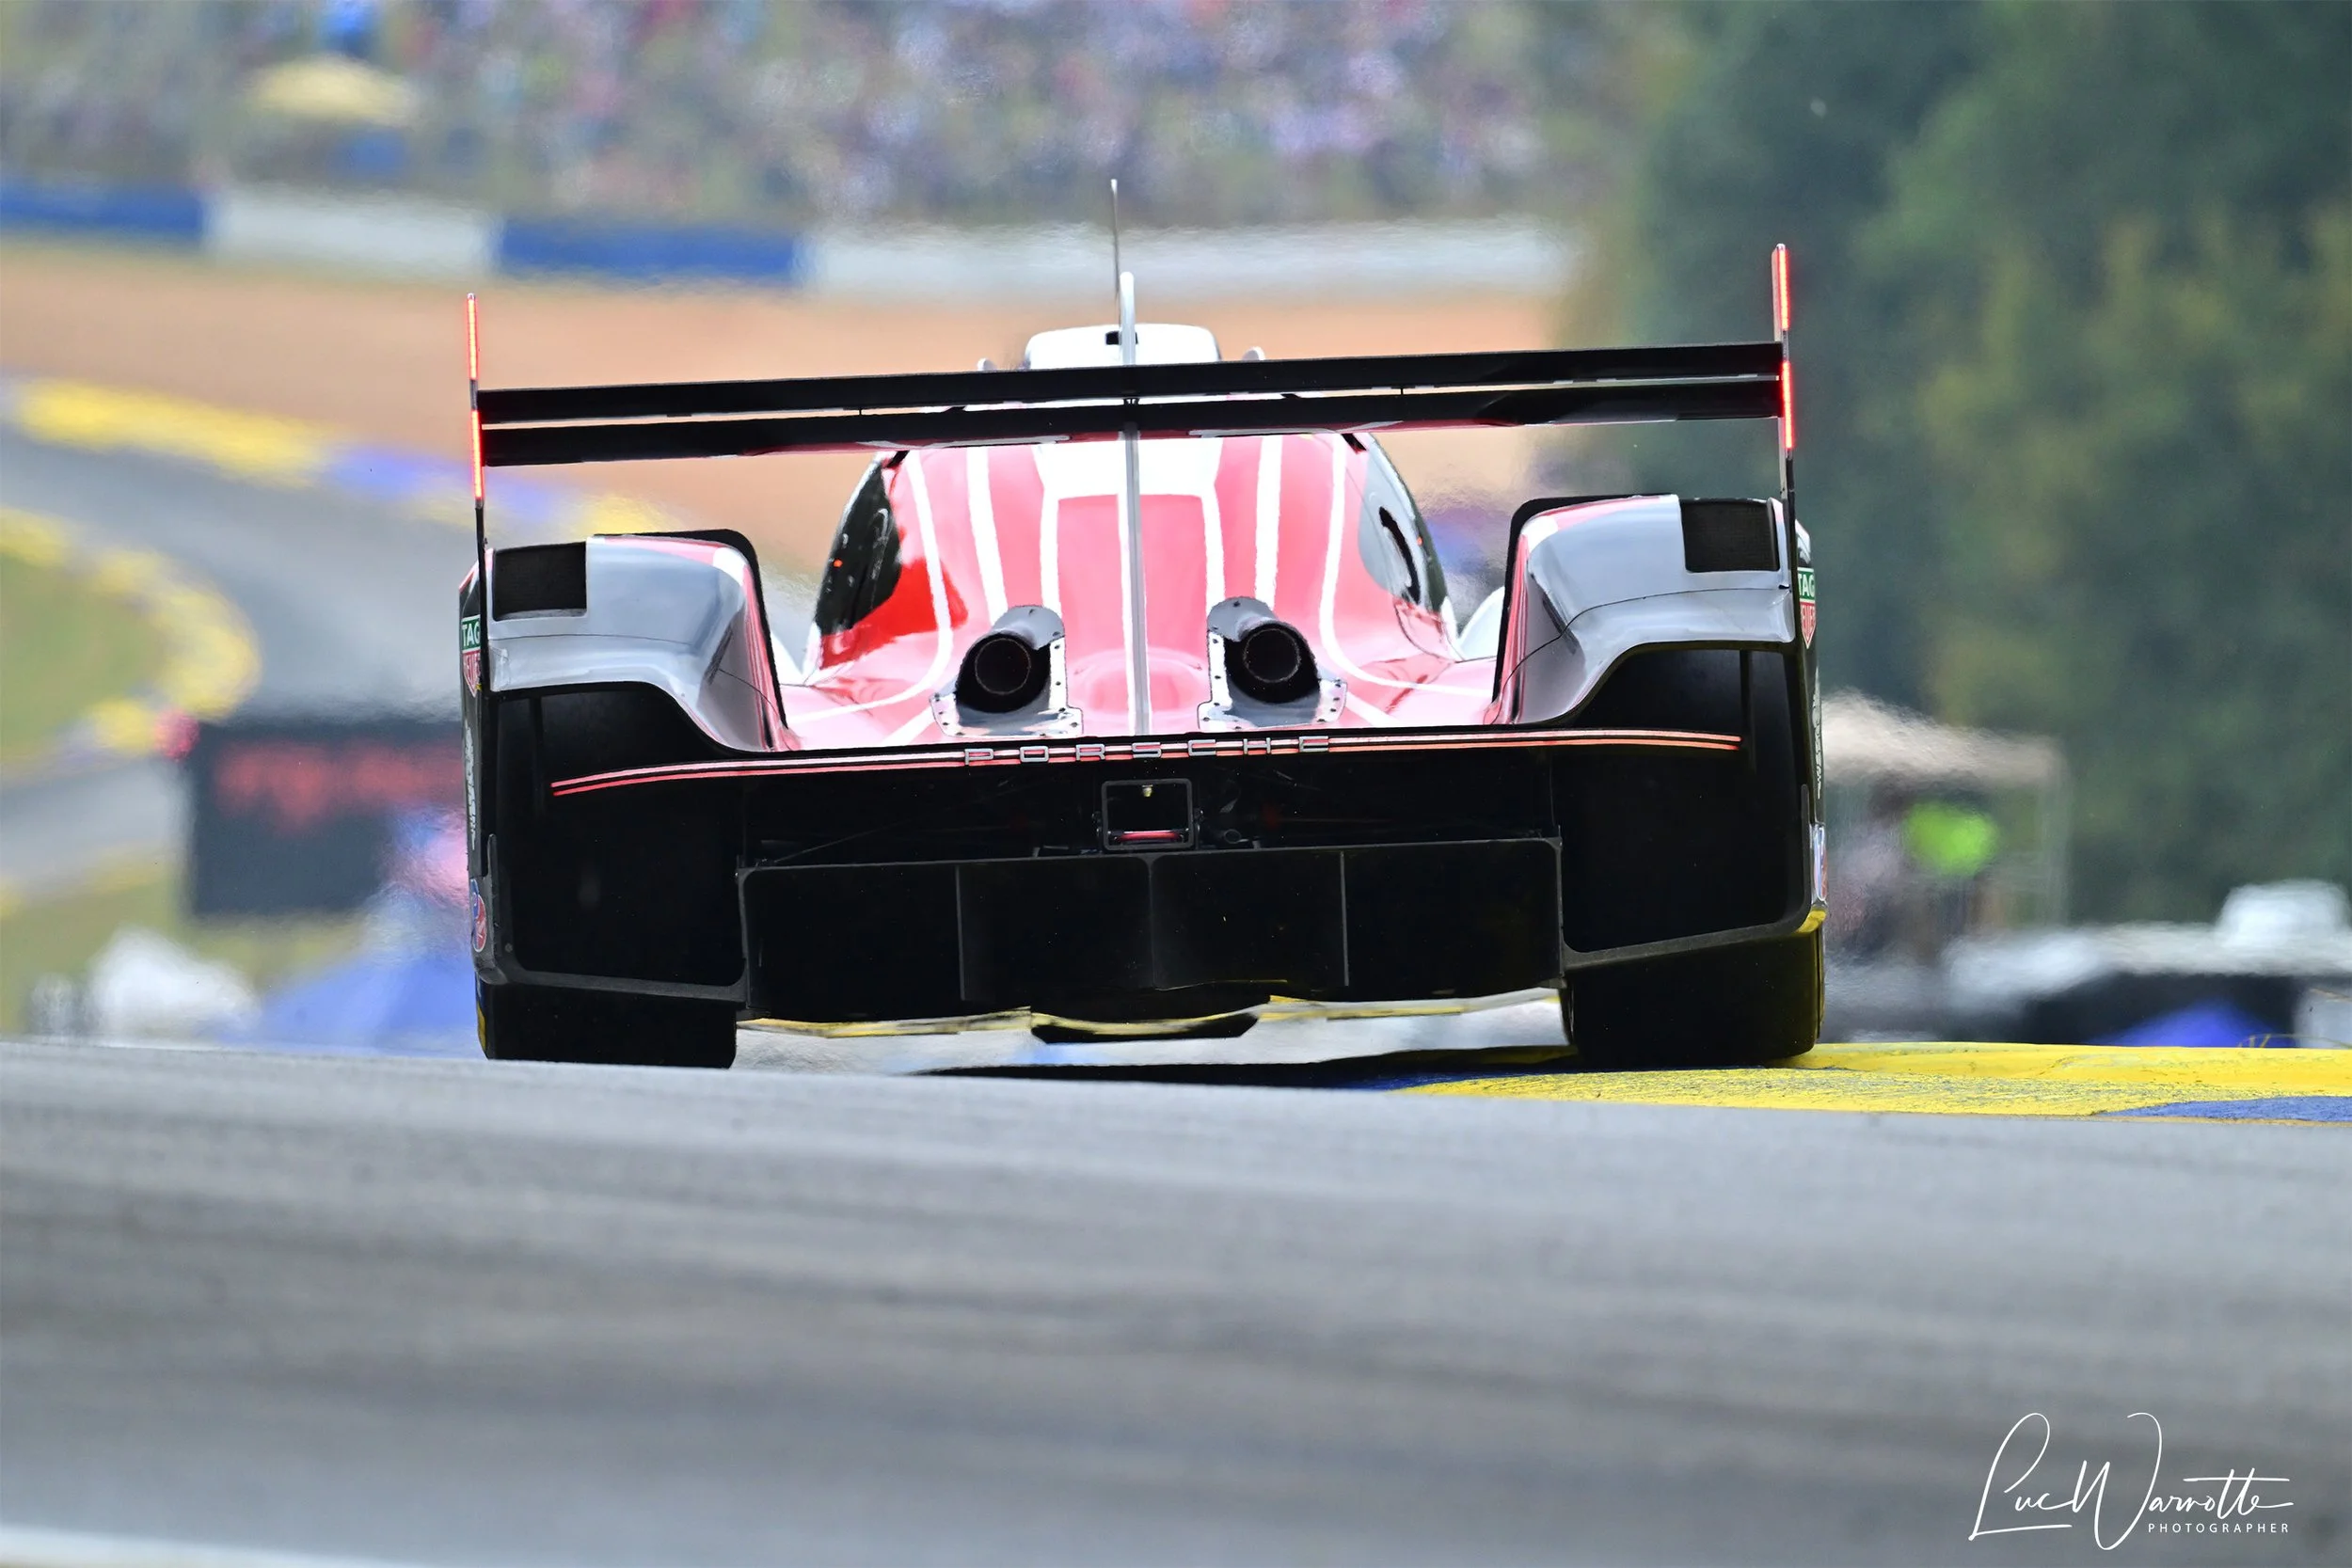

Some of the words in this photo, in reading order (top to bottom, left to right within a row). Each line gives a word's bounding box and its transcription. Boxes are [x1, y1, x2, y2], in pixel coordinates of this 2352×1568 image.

[1798, 573, 1815, 598] TAG
[462, 622, 481, 647] TAG
[964, 736, 1328, 766] PORSCHE
